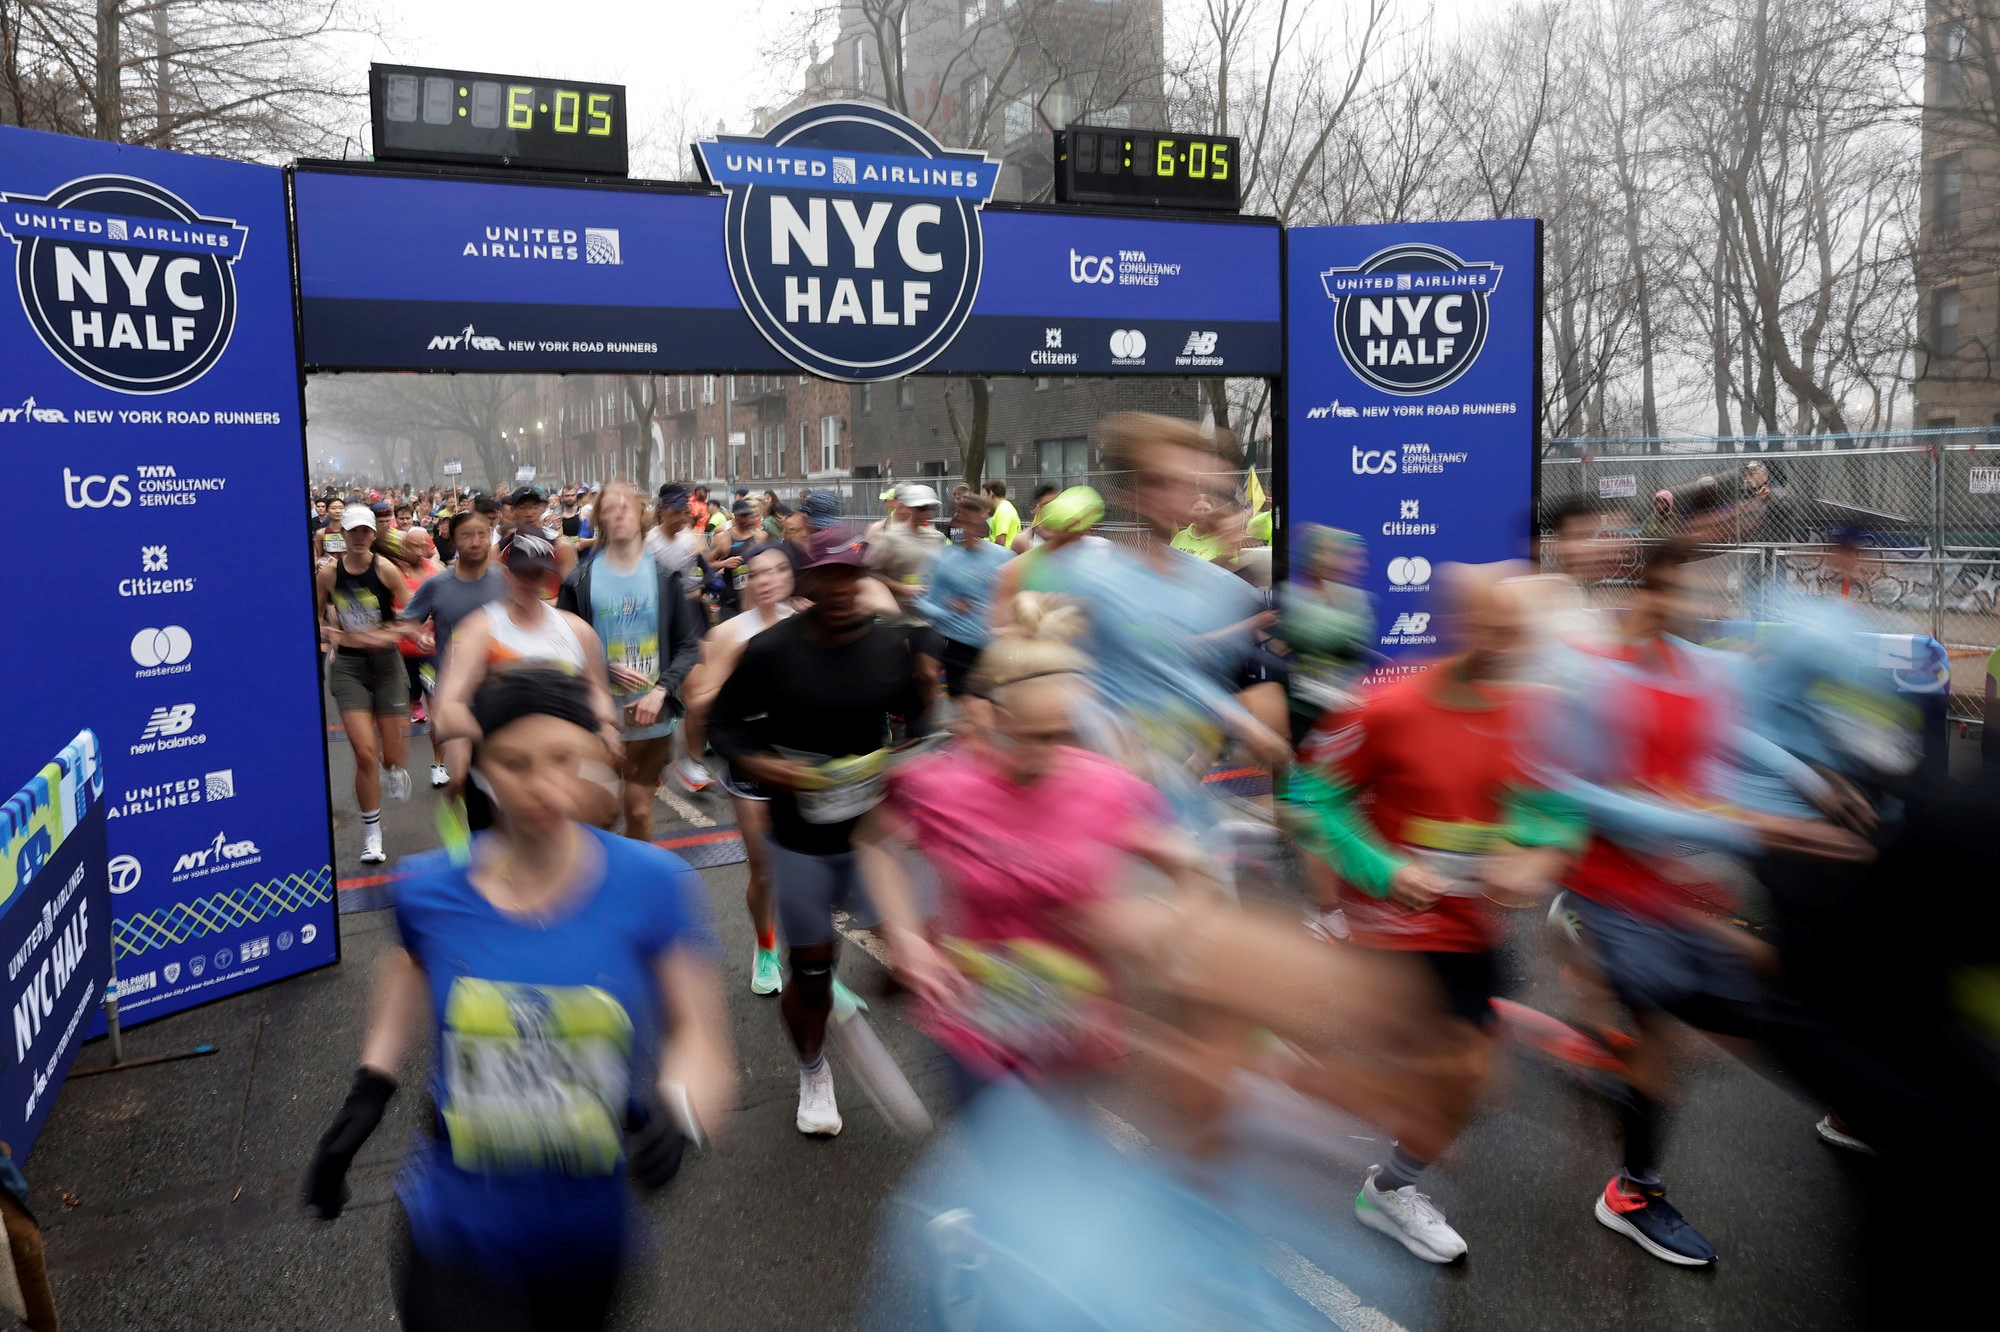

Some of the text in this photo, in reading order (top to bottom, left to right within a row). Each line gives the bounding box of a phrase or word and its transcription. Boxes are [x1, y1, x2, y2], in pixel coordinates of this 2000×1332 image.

[726, 155, 978, 187] UNITED AIRLINES
[15, 212, 229, 247] UNITED AIRLINES
[486, 226, 578, 244] UNITED
[770, 195, 943, 273] NYC
[463, 242, 579, 260] AIRLINES
[1119, 250, 1146, 262] TATA
[1069, 248, 1115, 284] tcs
[1119, 263, 1181, 276] CONSULTANCY
[54, 246, 205, 311] NYC
[1119, 275, 1160, 286] SERVICES
[1337, 275, 1487, 290] UNITED AIRLINES
[785, 276, 931, 326] HALF
[1359, 294, 1463, 336] NYC
[71, 310, 195, 352] HALF
[508, 341, 536, 352] NEW
[538, 341, 570, 352] YORK
[572, 342, 604, 353] ROAD
[607, 342, 658, 353] RUNNERS
[1366, 338, 1455, 366] HALF
[1031, 351, 1077, 365] Citizens
[1111, 357, 1146, 366] mastercard
[1175, 356, 1224, 366] new balance
[74, 409, 114, 424] NEW
[118, 410, 164, 424] YORK
[167, 411, 210, 424] ROAD
[214, 412, 281, 425] RUNNERS
[1363, 406, 1390, 417] NEW
[1393, 406, 1424, 417] YORK
[1427, 404, 1459, 416] ROAD
[1462, 403, 1517, 415] RUNNERS
[1402, 443, 1430, 454] TATA
[1352, 445, 1397, 475] tcs
[1402, 452, 1468, 464] CONSULTANCY
[137, 465, 176, 478] TATA
[1402, 464, 1444, 474] SERVICES
[63, 467, 132, 509] tcs
[138, 478, 226, 492] CONSULTANCY
[139, 493, 197, 507] SERVICES
[1382, 521, 1436, 536] Citizens
[118, 577, 195, 597] Citizens
[1388, 584, 1430, 593] mastercard
[1381, 635, 1437, 646] new balance
[135, 662, 192, 679] mastercard
[1375, 665, 1428, 676] UNITED
[130, 732, 207, 756] new balance
[125, 778, 200, 802] UNITED
[106, 790, 201, 821] AIRLINES
[172, 855, 262, 884] NEW YORK ROAD RUNNERS
[8, 860, 86, 982] UNITED AIRLINES
[12, 896, 88, 1065] NYC HALF
